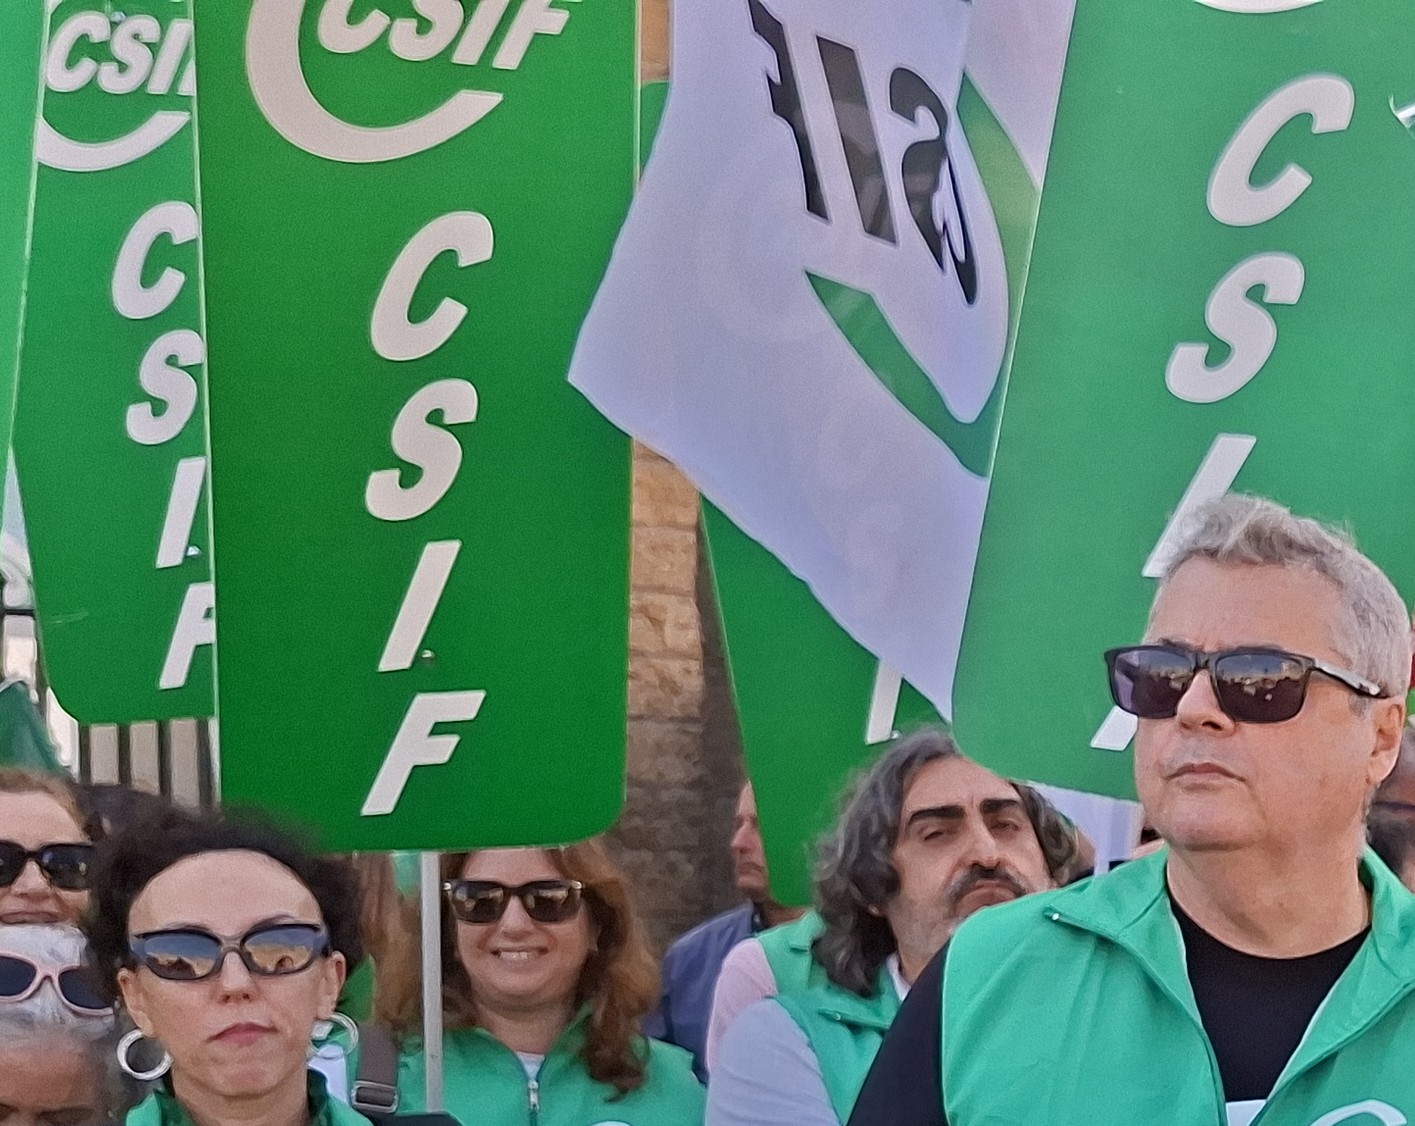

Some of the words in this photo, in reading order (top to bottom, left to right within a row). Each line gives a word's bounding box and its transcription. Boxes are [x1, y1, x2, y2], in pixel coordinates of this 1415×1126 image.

[45, 10, 196, 96] CSI
[360, 211, 495, 816] CSIF
[1090, 72, 1356, 752] CSI
